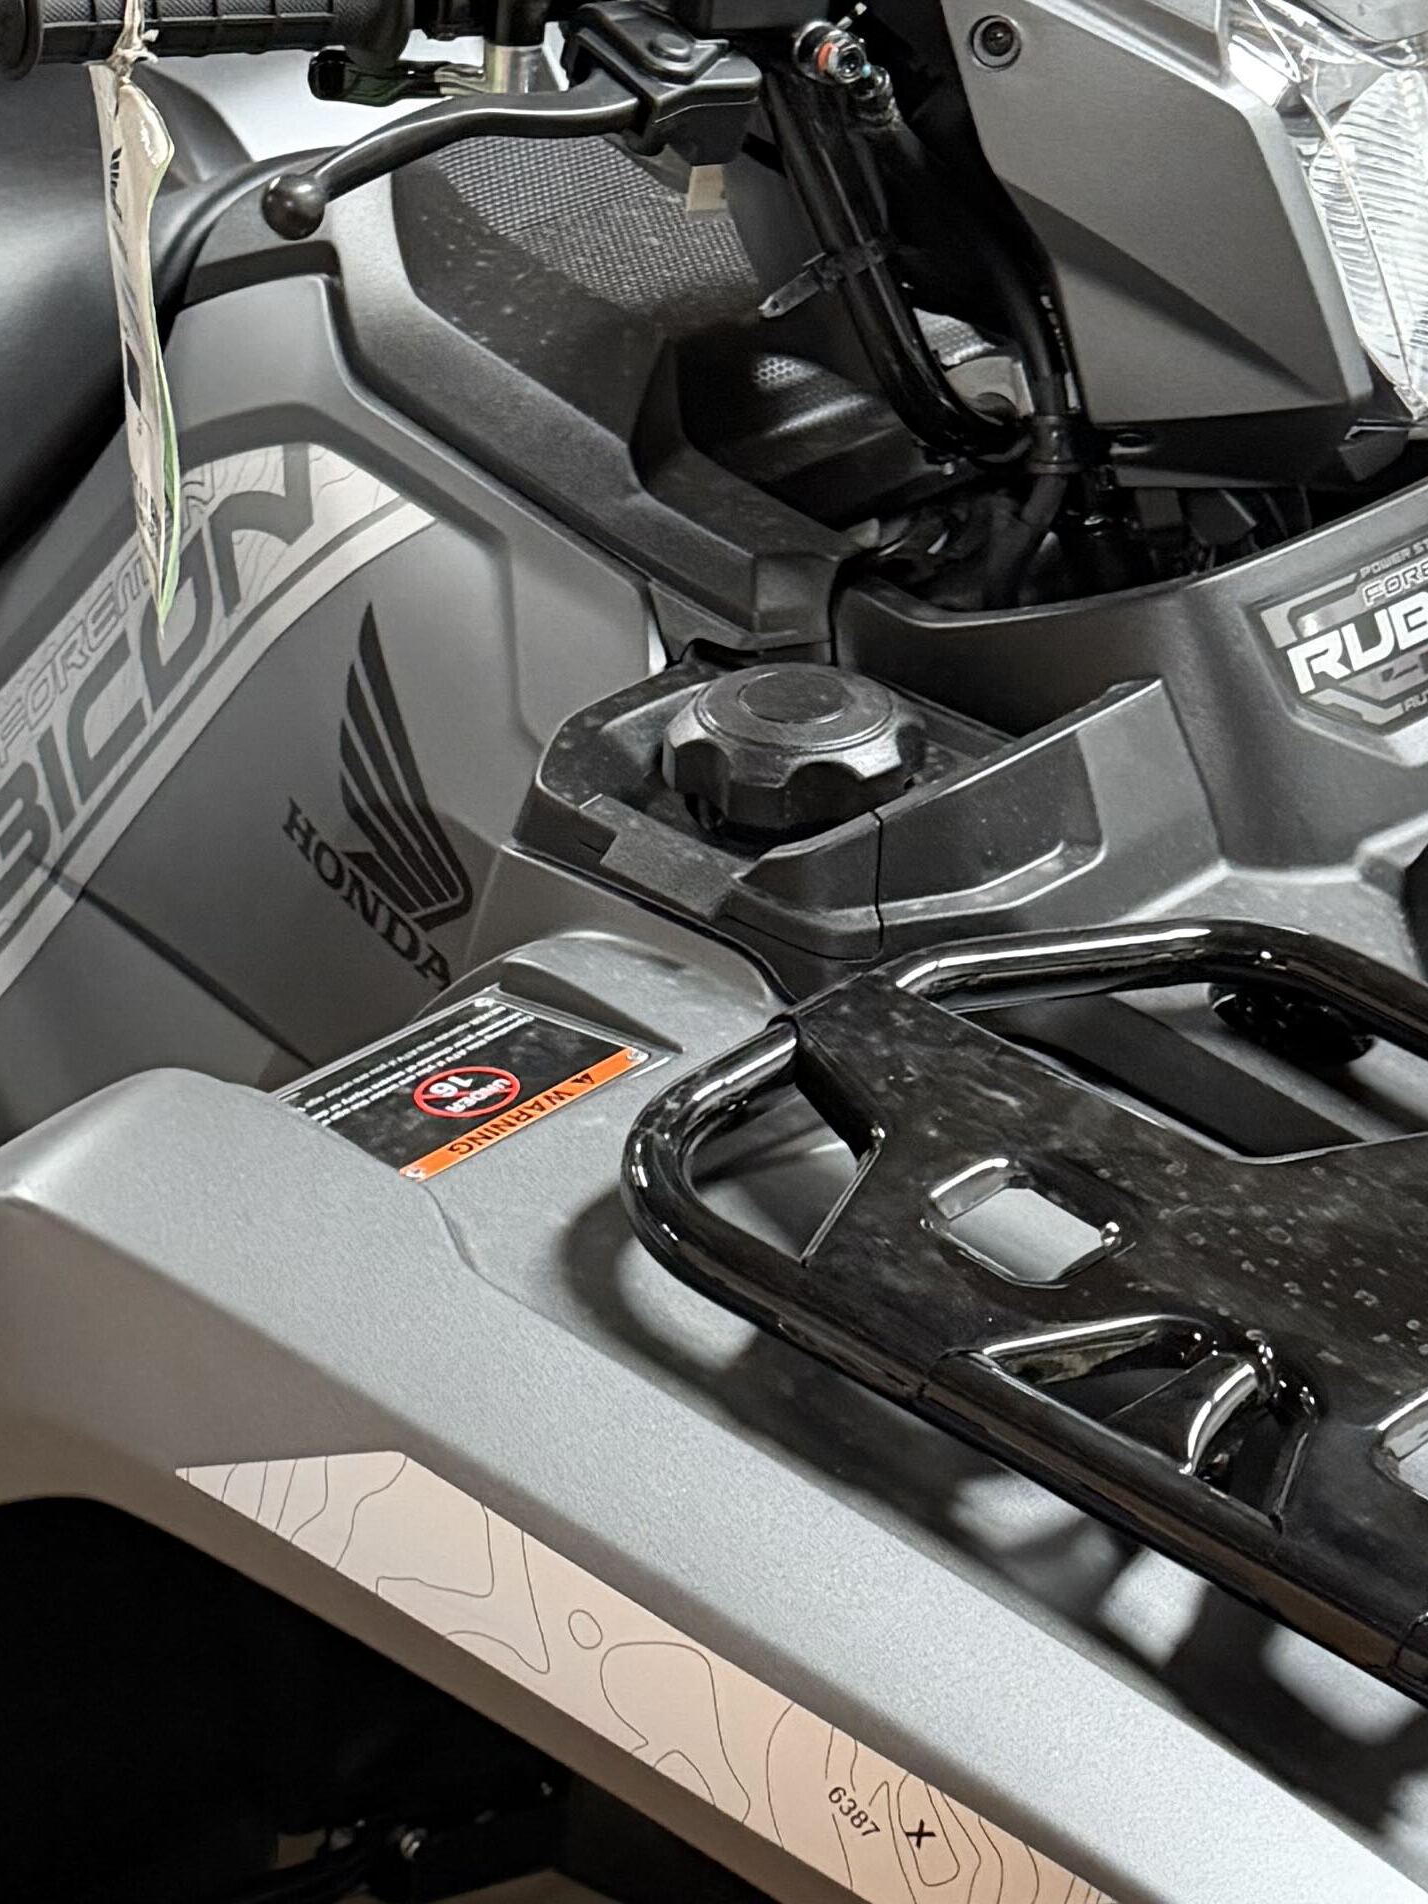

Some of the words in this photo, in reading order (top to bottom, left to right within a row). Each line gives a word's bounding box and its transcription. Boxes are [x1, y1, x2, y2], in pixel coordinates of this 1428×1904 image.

[282, 797, 452, 993] HONDA
[429, 1074, 474, 1099] 16
[447, 1089, 575, 1156] WARNING
[828, 1786, 881, 1837] 6387
